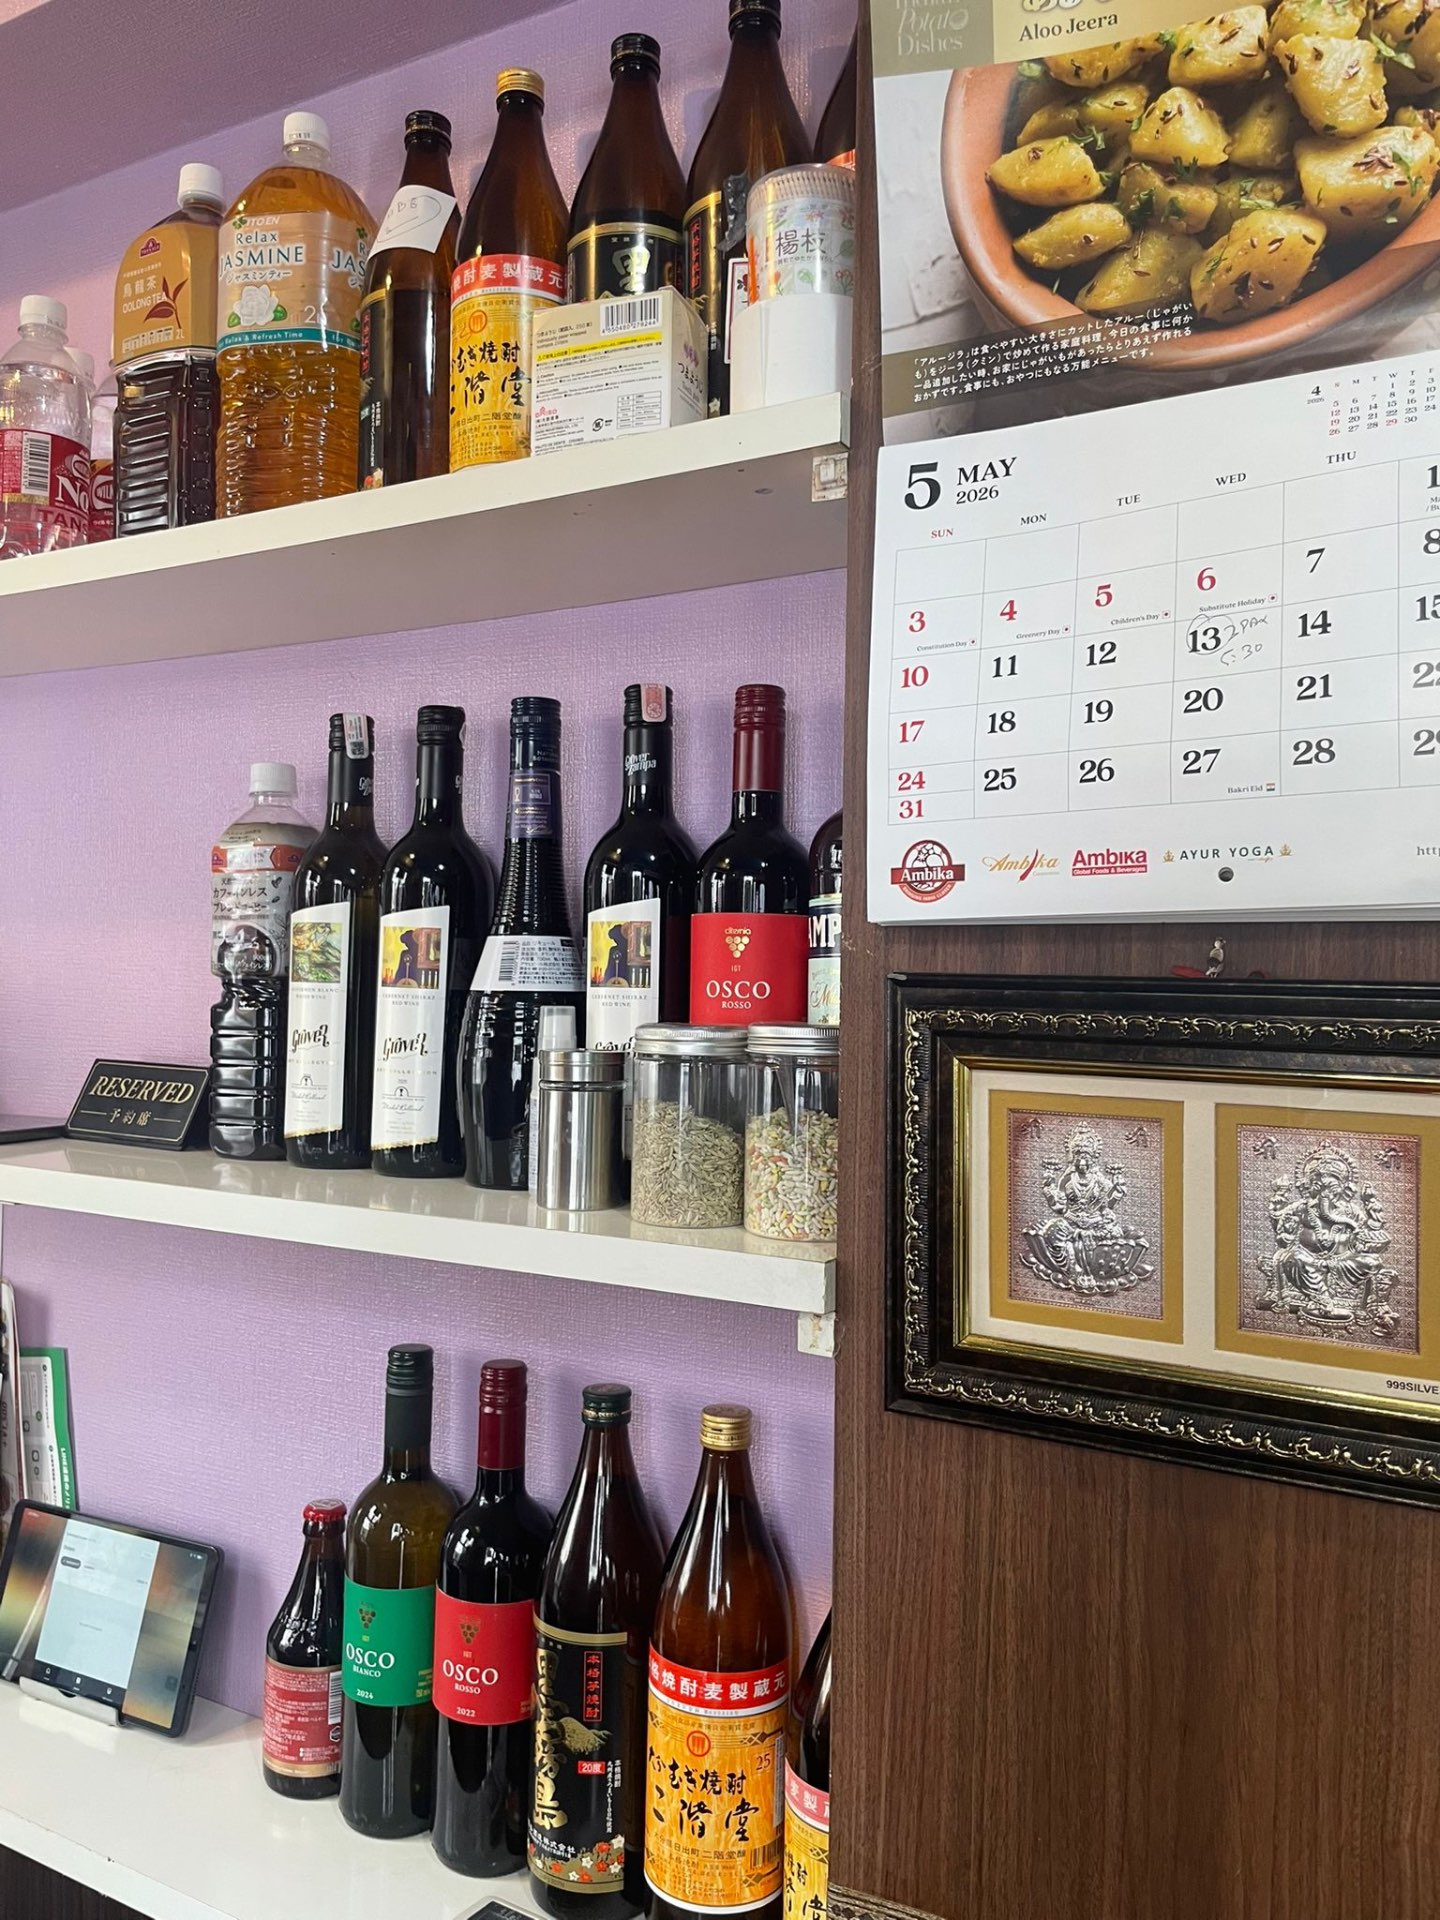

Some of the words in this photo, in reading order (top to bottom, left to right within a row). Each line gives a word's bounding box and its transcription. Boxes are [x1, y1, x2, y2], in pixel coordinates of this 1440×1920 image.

[1019, 23, 1062, 41] Aloo
[1066, 13, 1118, 34] Jeera
[898, 35, 963, 55] Dishes
[236, 231, 278, 245] Relax
[776, 228, 827, 257] 楊枝
[219, 246, 304, 277] JASMINE
[1311, 385, 1321, 396] 4
[1330, 409, 1340, 417] 12
[1350, 406, 1360, 414] 13
[1369, 403, 1378, 411] 14
[1387, 400, 1397, 408] 15
[1406, 397, 1417, 405] 16
[1330, 418, 1340, 426] 19
[1348, 415, 1360, 424] 20
[1368, 412, 1378, 420] 21
[1386, 409, 1398, 417] 22
[1405, 406, 1417, 414] 23
[1424, 404, 1436, 412] 24
[1329, 428, 1340, 436] 26
[1348, 424, 1360, 432] 27
[1367, 421, 1378, 430] 28
[1386, 418, 1398, 426] 29
[1404, 416, 1417, 424] 30
[904, 461, 941, 510] 5
[956, 456, 1017, 486] MAY
[931, 528, 954, 539] SUN
[1020, 513, 1047, 526] MON
[1117, 494, 1141, 507] TUE
[1215, 472, 1246, 486] WED
[1326, 451, 1357, 464] THU
[956, 485, 999, 505] 2026
[909, 610, 926, 632] 3
[999, 599, 1017, 621] 4
[1094, 583, 1114, 607] 5
[1196, 567, 1216, 591] 6
[1306, 547, 1326, 573] 7
[1423, 528, 1440, 554] 8
[1199, 602, 1236, 613] Substitute
[1237, 597, 1267, 608] Holiday
[1110, 615, 1146, 626] Children's
[1146, 612, 1160, 621] Day
[955, 640, 968, 648] Day
[1016, 630, 1047, 640] Greenery
[1048, 628, 1061, 637] Day
[901, 665, 929, 688] 10
[991, 654, 1018, 678] 11
[1086, 641, 1117, 666] 12
[1188, 627, 1222, 653] 13
[1297, 610, 1332, 638] 14
[899, 720, 926, 743] 17
[987, 710, 1016, 734] 18
[1084, 700, 1113, 724] 19
[1183, 687, 1223, 713] 20
[1296, 673, 1333, 701] 21
[1412, 661, 1440, 688] 2
[898, 771, 925, 791] 24
[983, 767, 1017, 791] 25
[1079, 758, 1115, 783] 26
[1182, 748, 1222, 774] 27
[1292, 738, 1336, 765] 28
[1227, 785, 1249, 794] Bakri
[1250, 784, 1263, 793] Eid
[899, 799, 924, 819] 31
[1180, 849, 1220, 860] AYUR
[1230, 845, 1274, 858] YOGA
[900, 868, 954, 882] Ambika
[706, 980, 771, 999] OSCO
[721, 1001, 752, 1010] ROSSO
[89, 1075, 195, 1105] RESERVED
[1386, 1379, 1440, 1395] 999SILVE
[346, 1642, 395, 1669] OSCO
[352, 1665, 381, 1678] BIANCO
[442, 1659, 499, 1685] OSCO
[356, 1688, 374, 1700] 2024
[454, 1683, 481, 1695] ROSSO
[456, 1706, 476, 1718] 2022
[756, 1752, 771, 1770] 25
